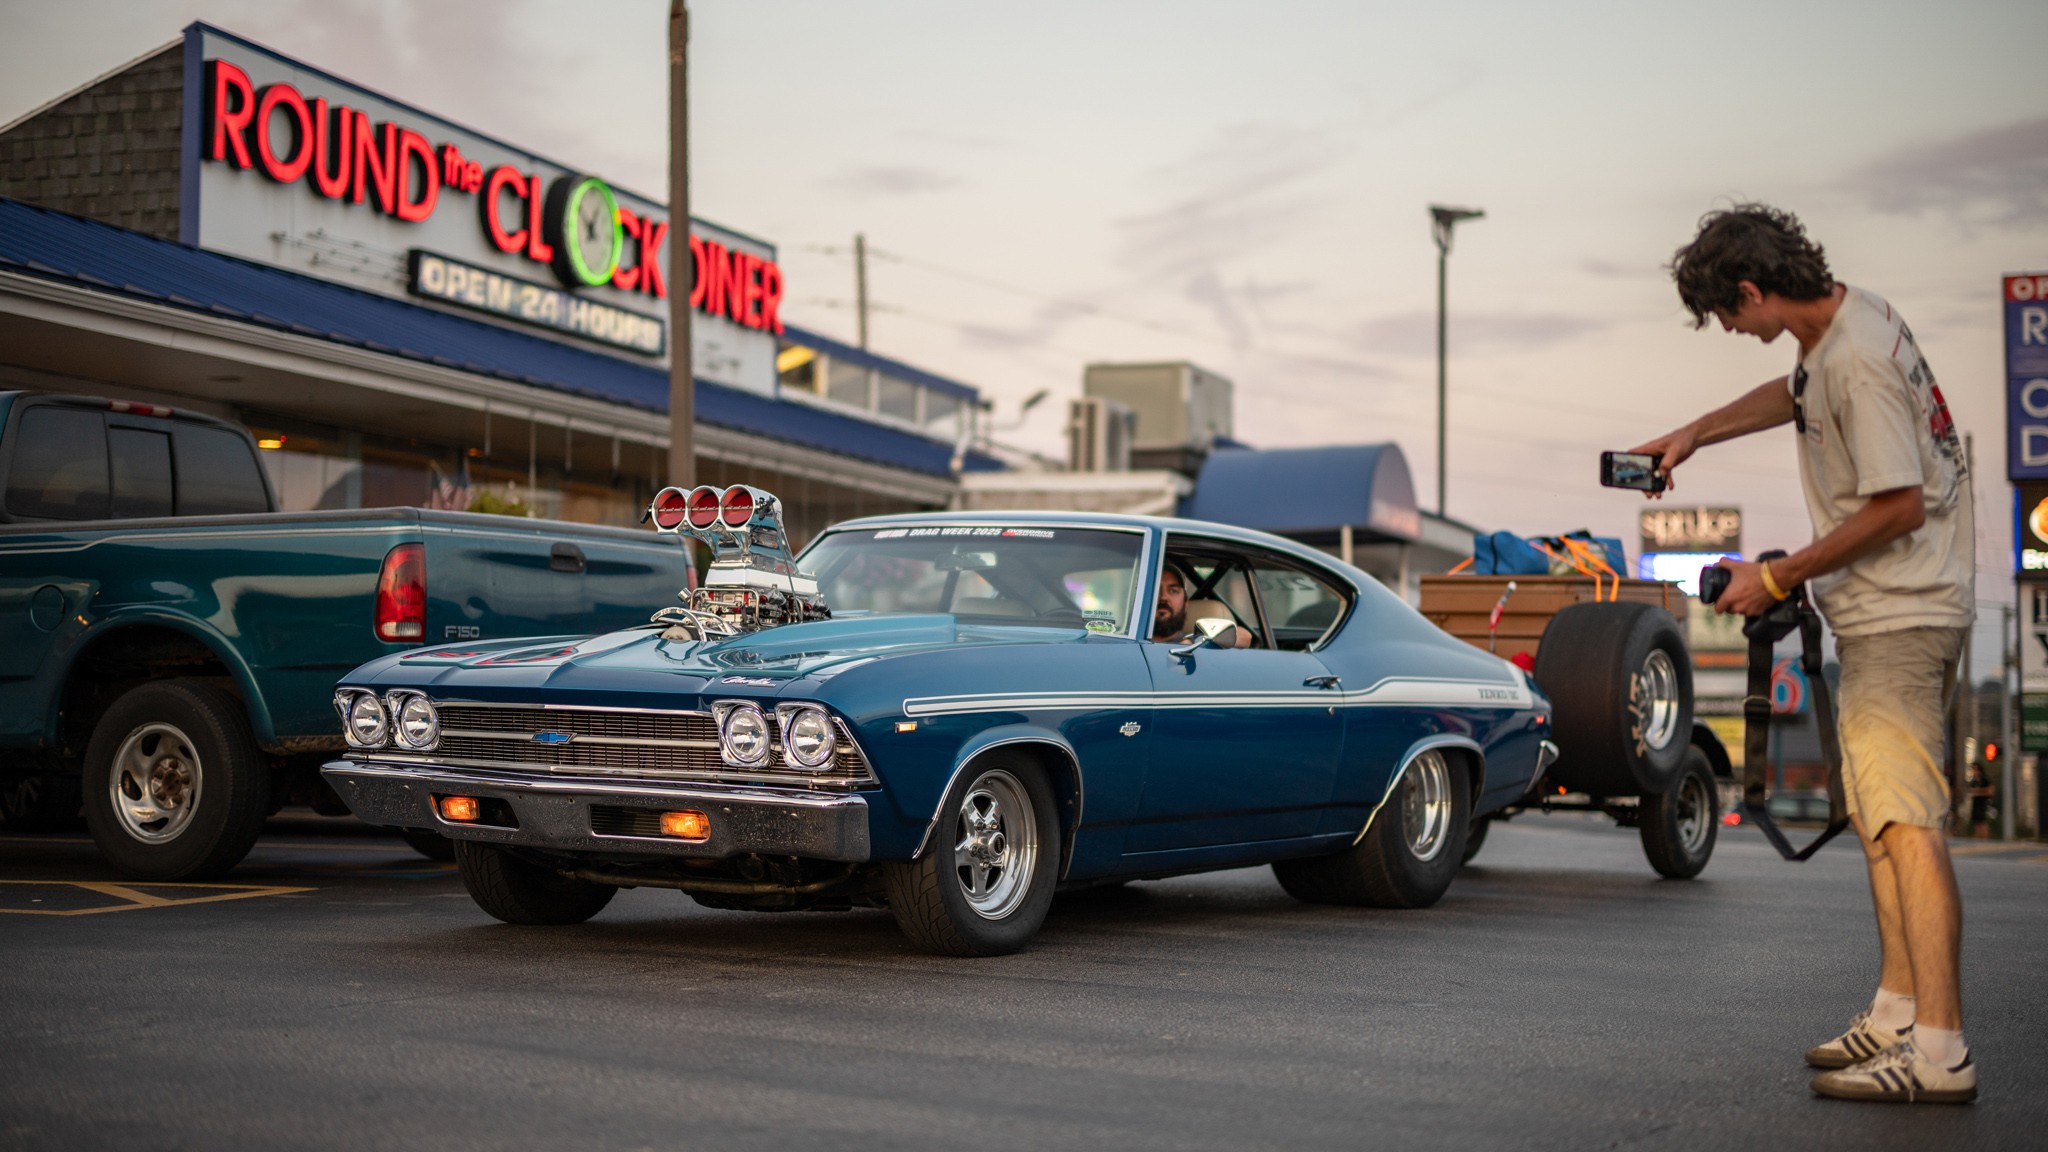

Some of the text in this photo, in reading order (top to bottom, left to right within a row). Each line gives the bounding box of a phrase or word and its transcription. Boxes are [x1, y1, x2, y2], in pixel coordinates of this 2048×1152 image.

[212, 58, 440, 223] ROUND
[443, 142, 484, 195] the
[486, 164, 668, 298] CLOCK
[420, 256, 512, 312] OPEN
[520, 286, 559, 318] 24
[909, 528, 941, 537] DRAG
[941, 527, 973, 536] WEEK
[972, 528, 1002, 536] 2025
[1770, 658, 1801, 714] 6
